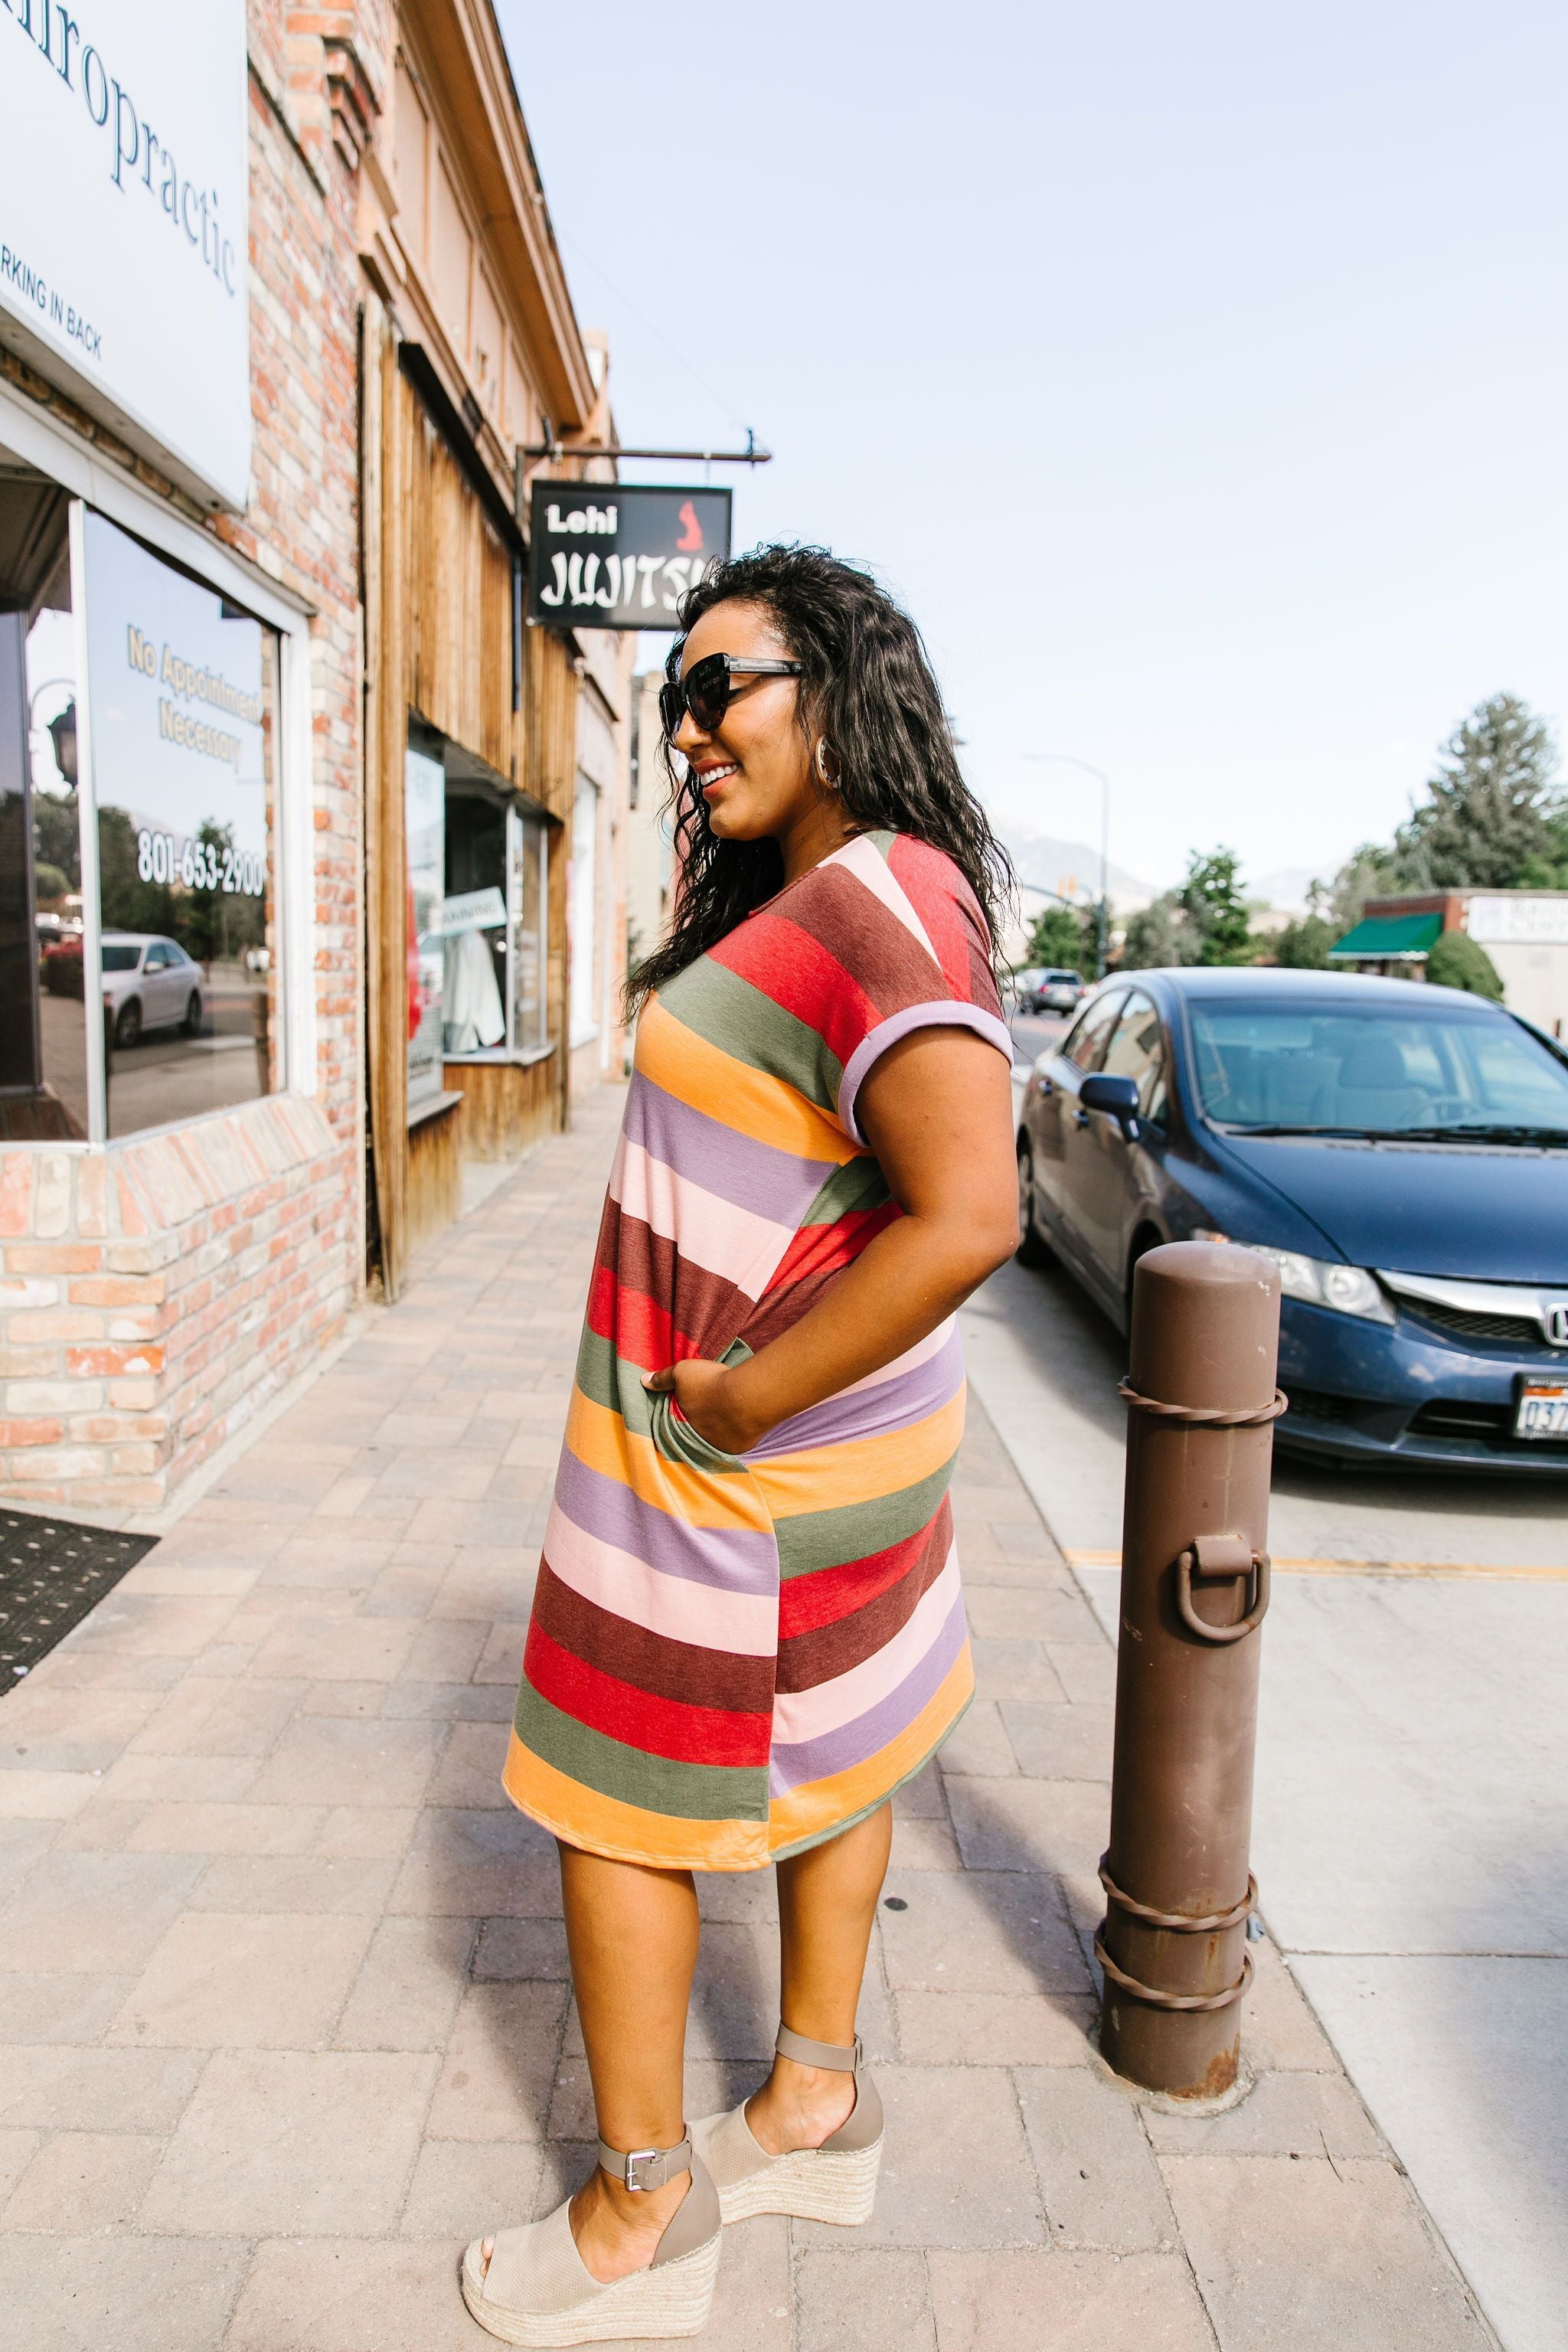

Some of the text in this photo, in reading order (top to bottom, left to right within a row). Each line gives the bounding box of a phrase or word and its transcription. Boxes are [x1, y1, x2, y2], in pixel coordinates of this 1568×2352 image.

[0, 0, 235, 297] iropractic
[51, 291, 63, 325] IN
[67, 306, 101, 360] BACK
[547, 505, 617, 534] Lehi
[129, 623, 261, 727] No Appointment
[158, 697, 243, 774] Necessary
[138, 828, 263, 897] 801-653-2900
